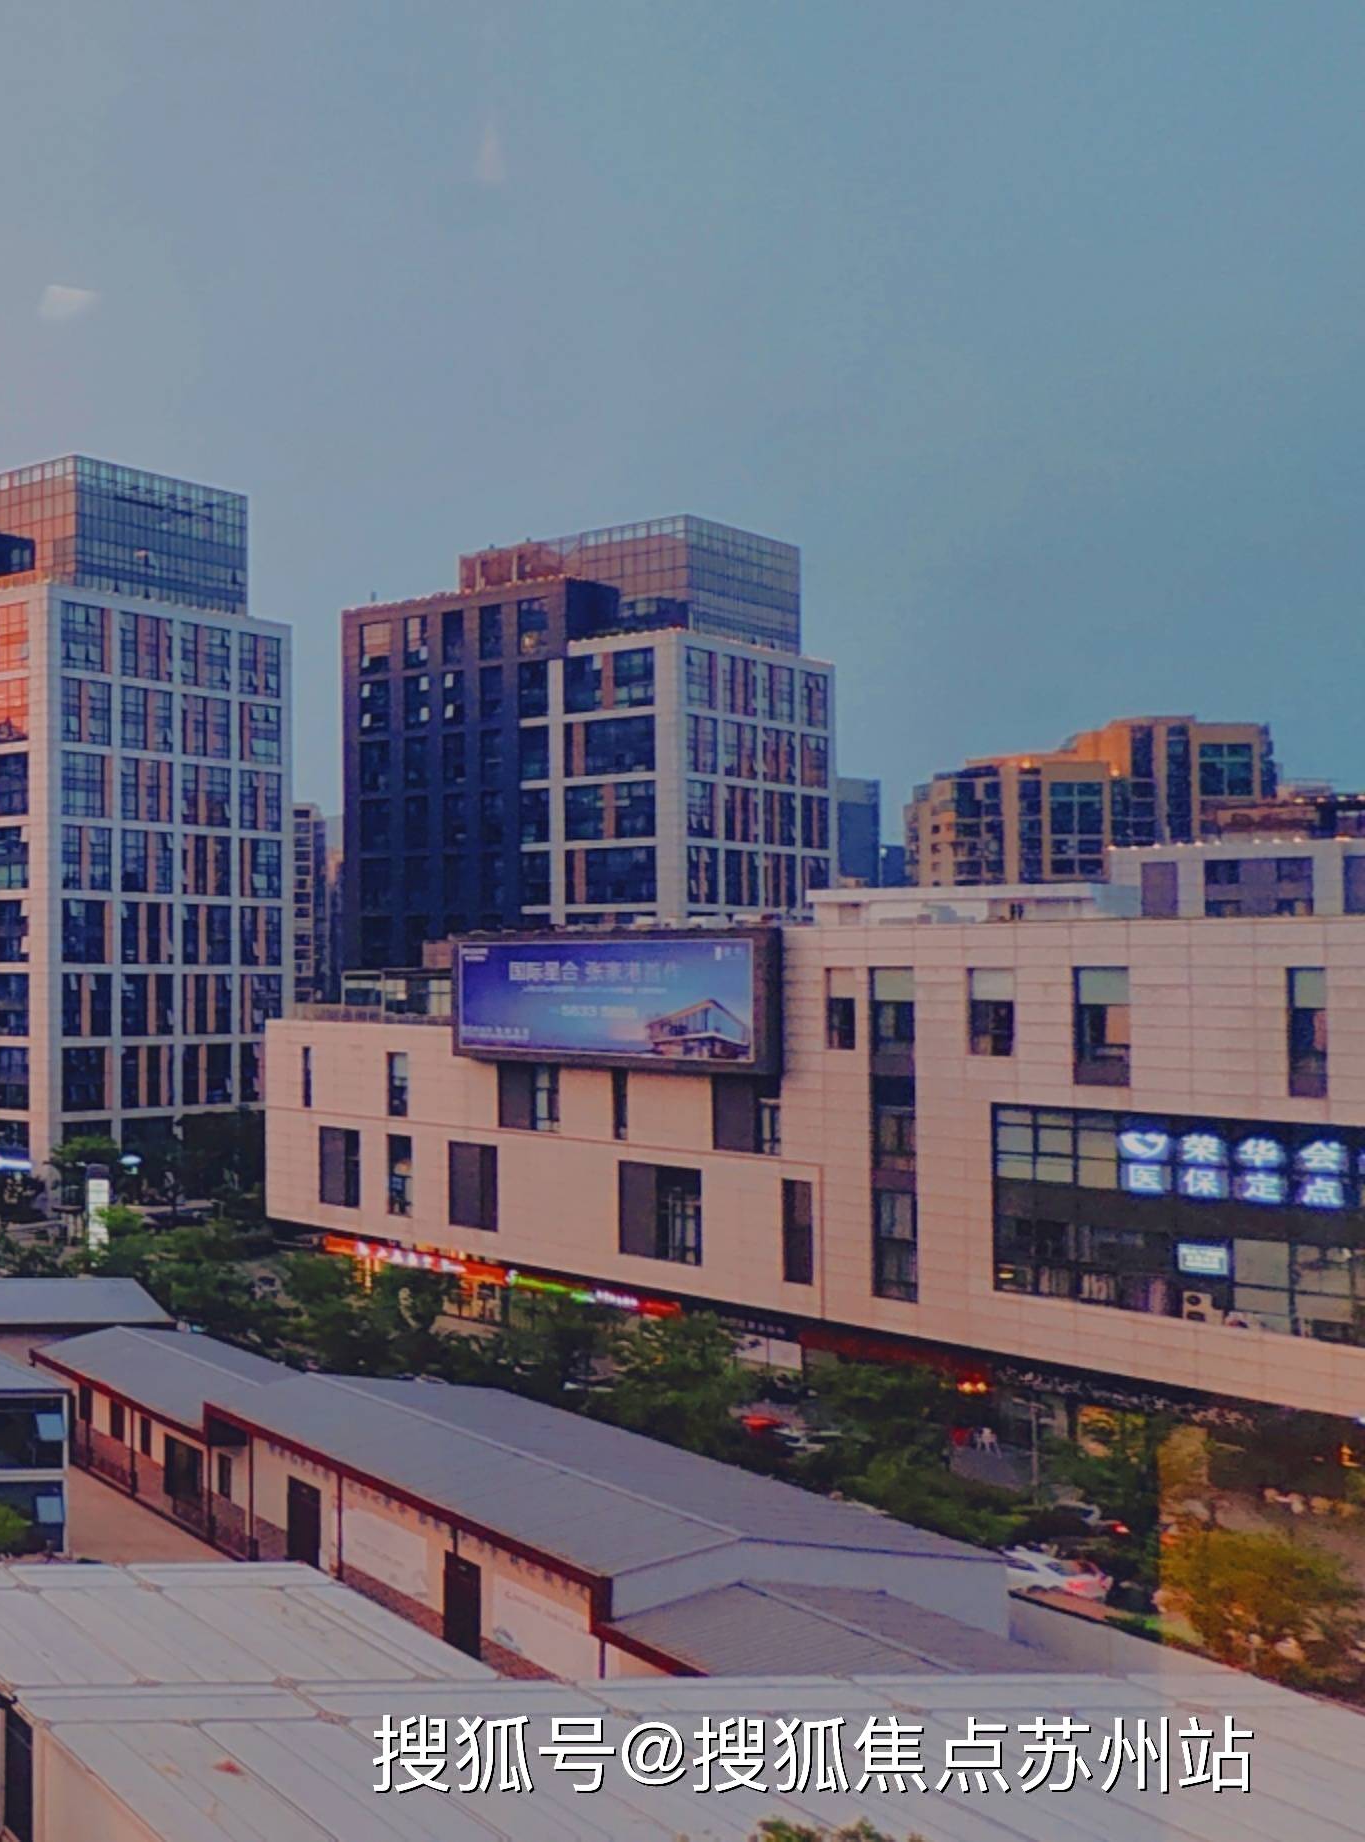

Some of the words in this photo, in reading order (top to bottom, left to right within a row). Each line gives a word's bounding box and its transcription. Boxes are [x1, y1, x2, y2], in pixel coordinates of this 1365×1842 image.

[1182, 1133, 1344, 1171] 荣华会
[1129, 1164, 1346, 1208] 医保定点
